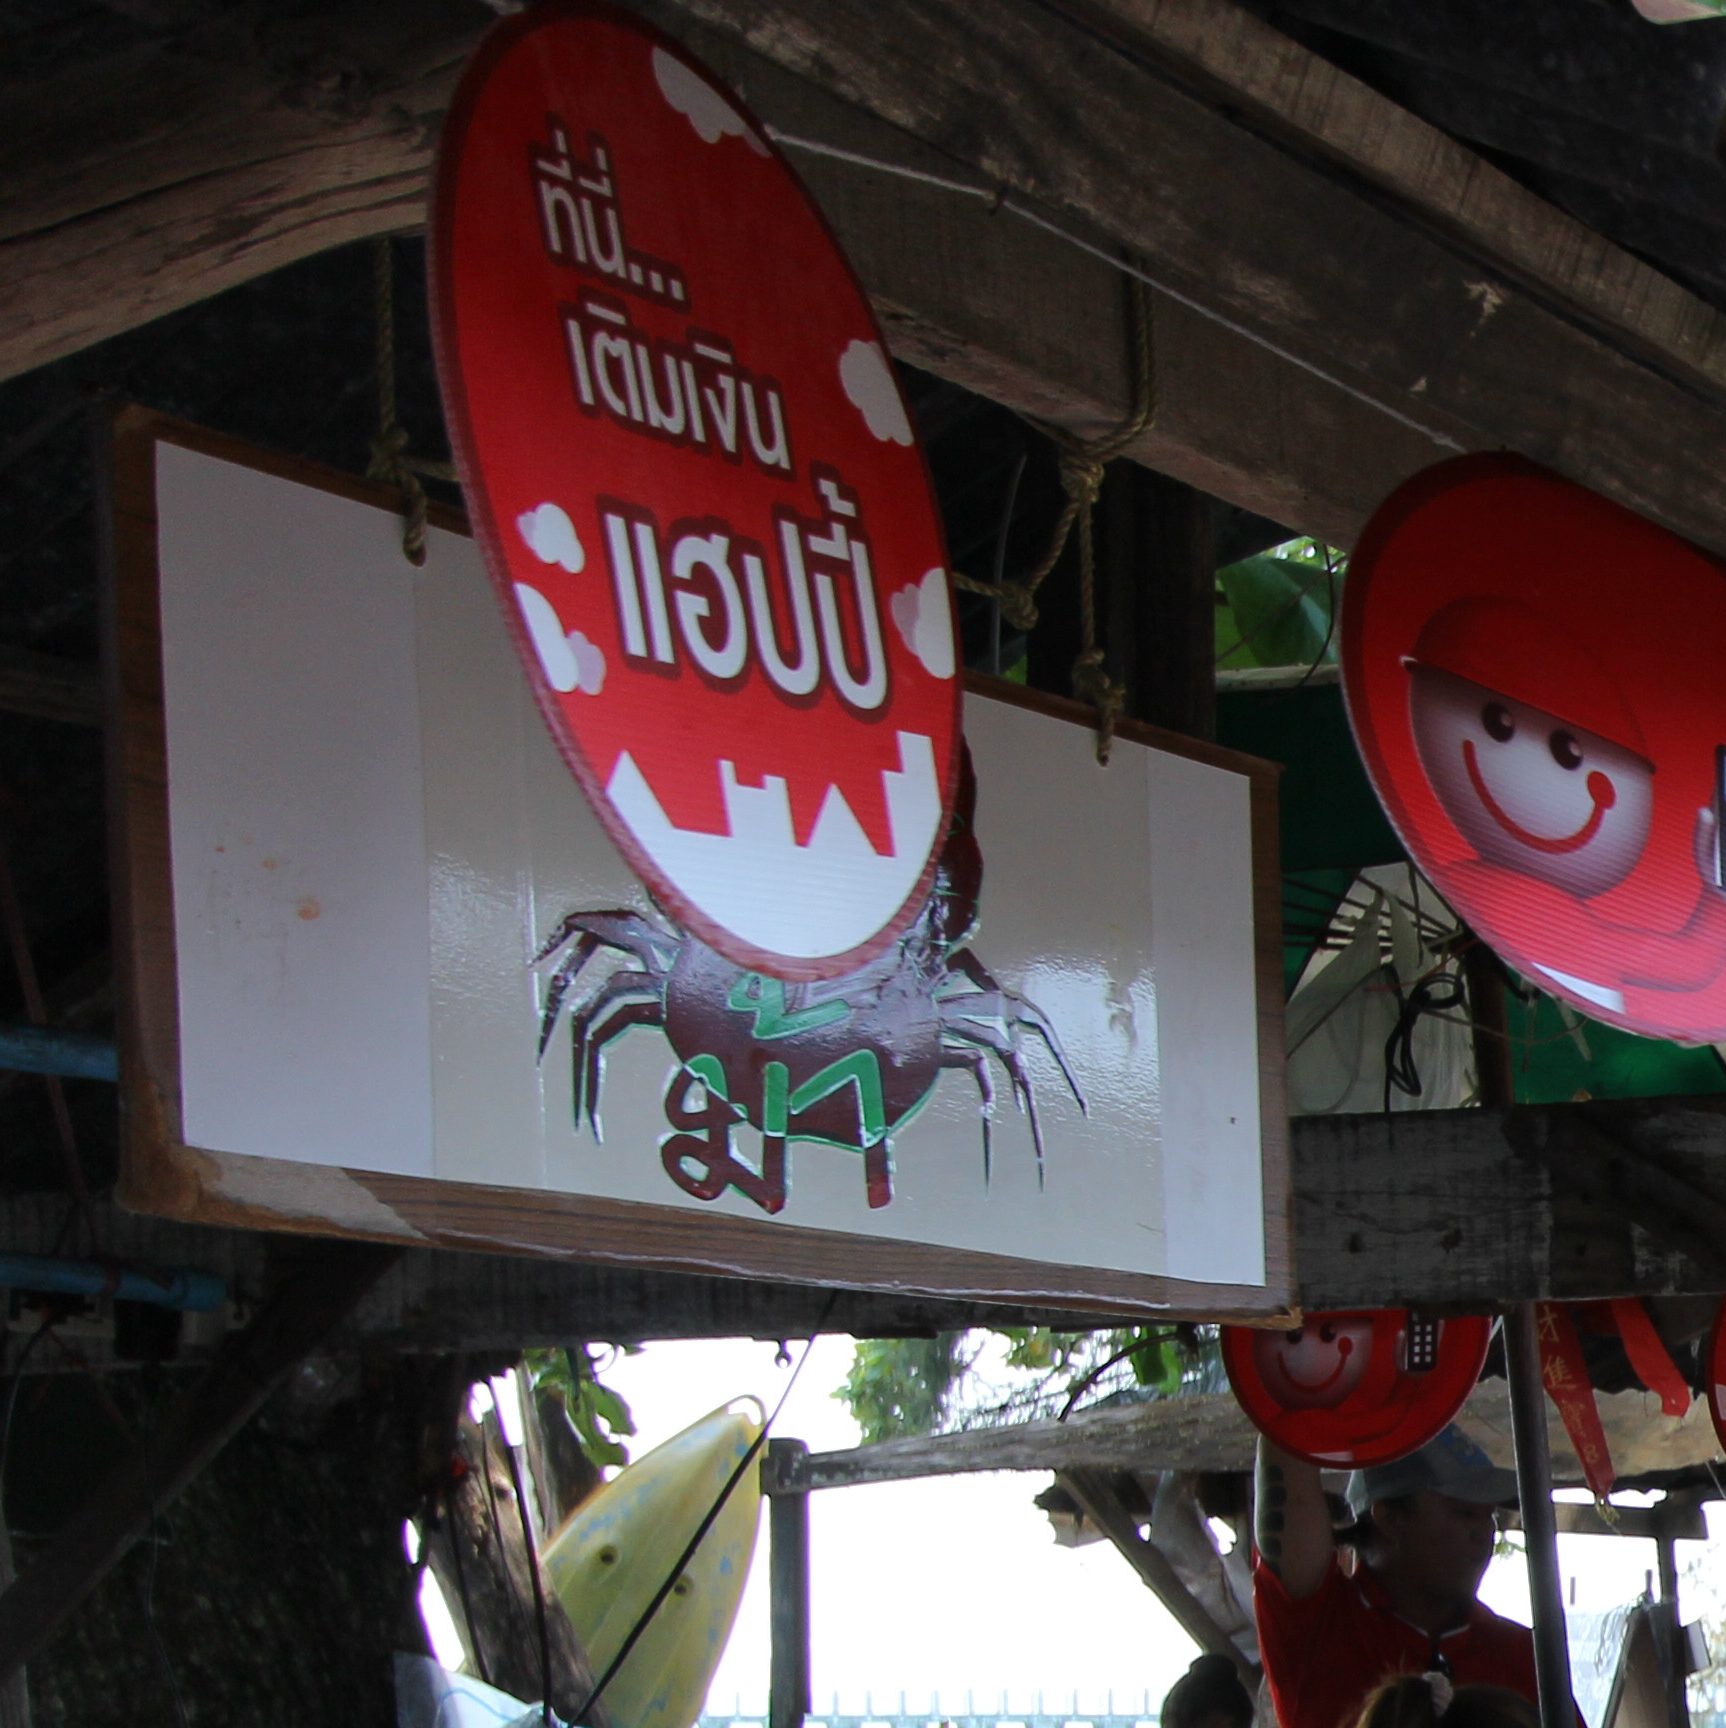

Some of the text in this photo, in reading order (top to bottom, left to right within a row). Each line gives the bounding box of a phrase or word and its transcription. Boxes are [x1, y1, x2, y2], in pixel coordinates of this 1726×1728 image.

[566, 302, 790, 471] เติมเงิน
[604, 484, 890, 711] แฮปปี้
